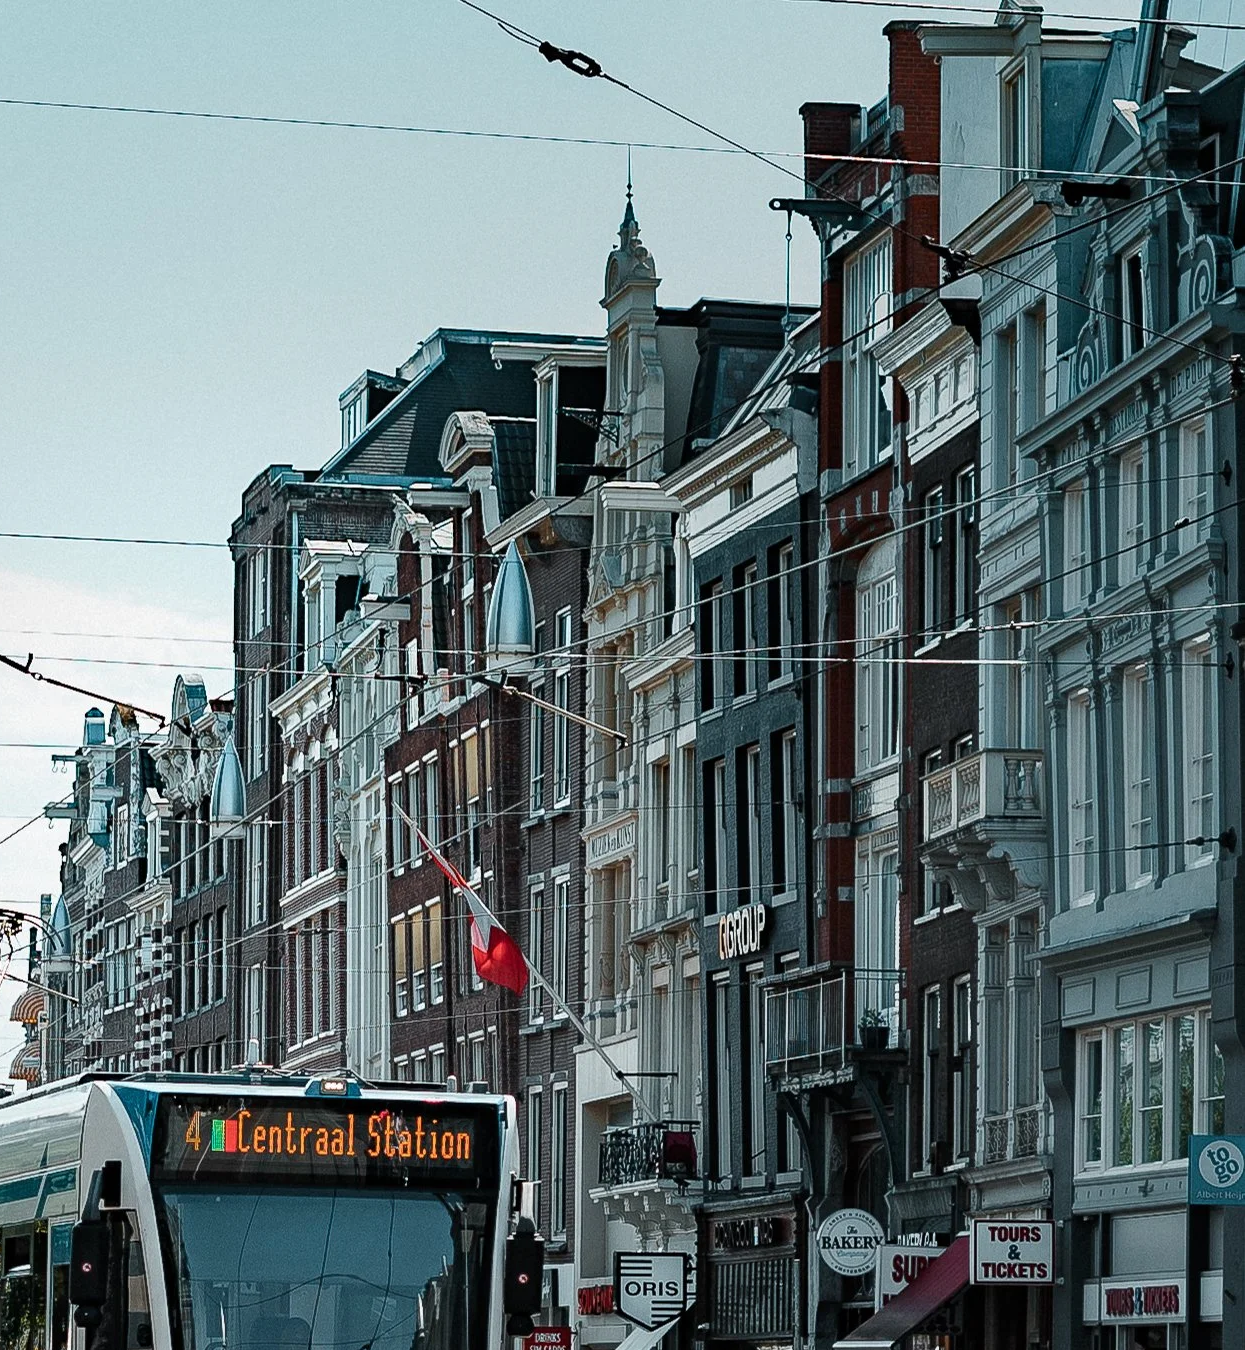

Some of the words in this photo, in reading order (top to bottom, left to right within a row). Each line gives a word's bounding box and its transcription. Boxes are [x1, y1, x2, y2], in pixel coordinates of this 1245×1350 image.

[185, 1110, 201, 1151] 4
[238, 1111, 355, 1156] Centraal
[368, 1114, 471, 1160] Station
[1207, 1147, 1230, 1166] to
[1215, 1159, 1240, 1184] go
[1196, 1190, 1223, 1200] Albert
[846, 1225, 858, 1235] The
[987, 1226, 1042, 1243] TOURS
[821, 1236, 884, 1249] BAKERY
[1007, 1244, 1021, 1260] &
[981, 1262, 1048, 1278] TICKETS
[625, 1281, 679, 1297] ORIS
[1105, 1287, 1134, 1317] TOURS
[1142, 1284, 1180, 1315] TICKETS
[534, 1332, 561, 1344] DRINKS
